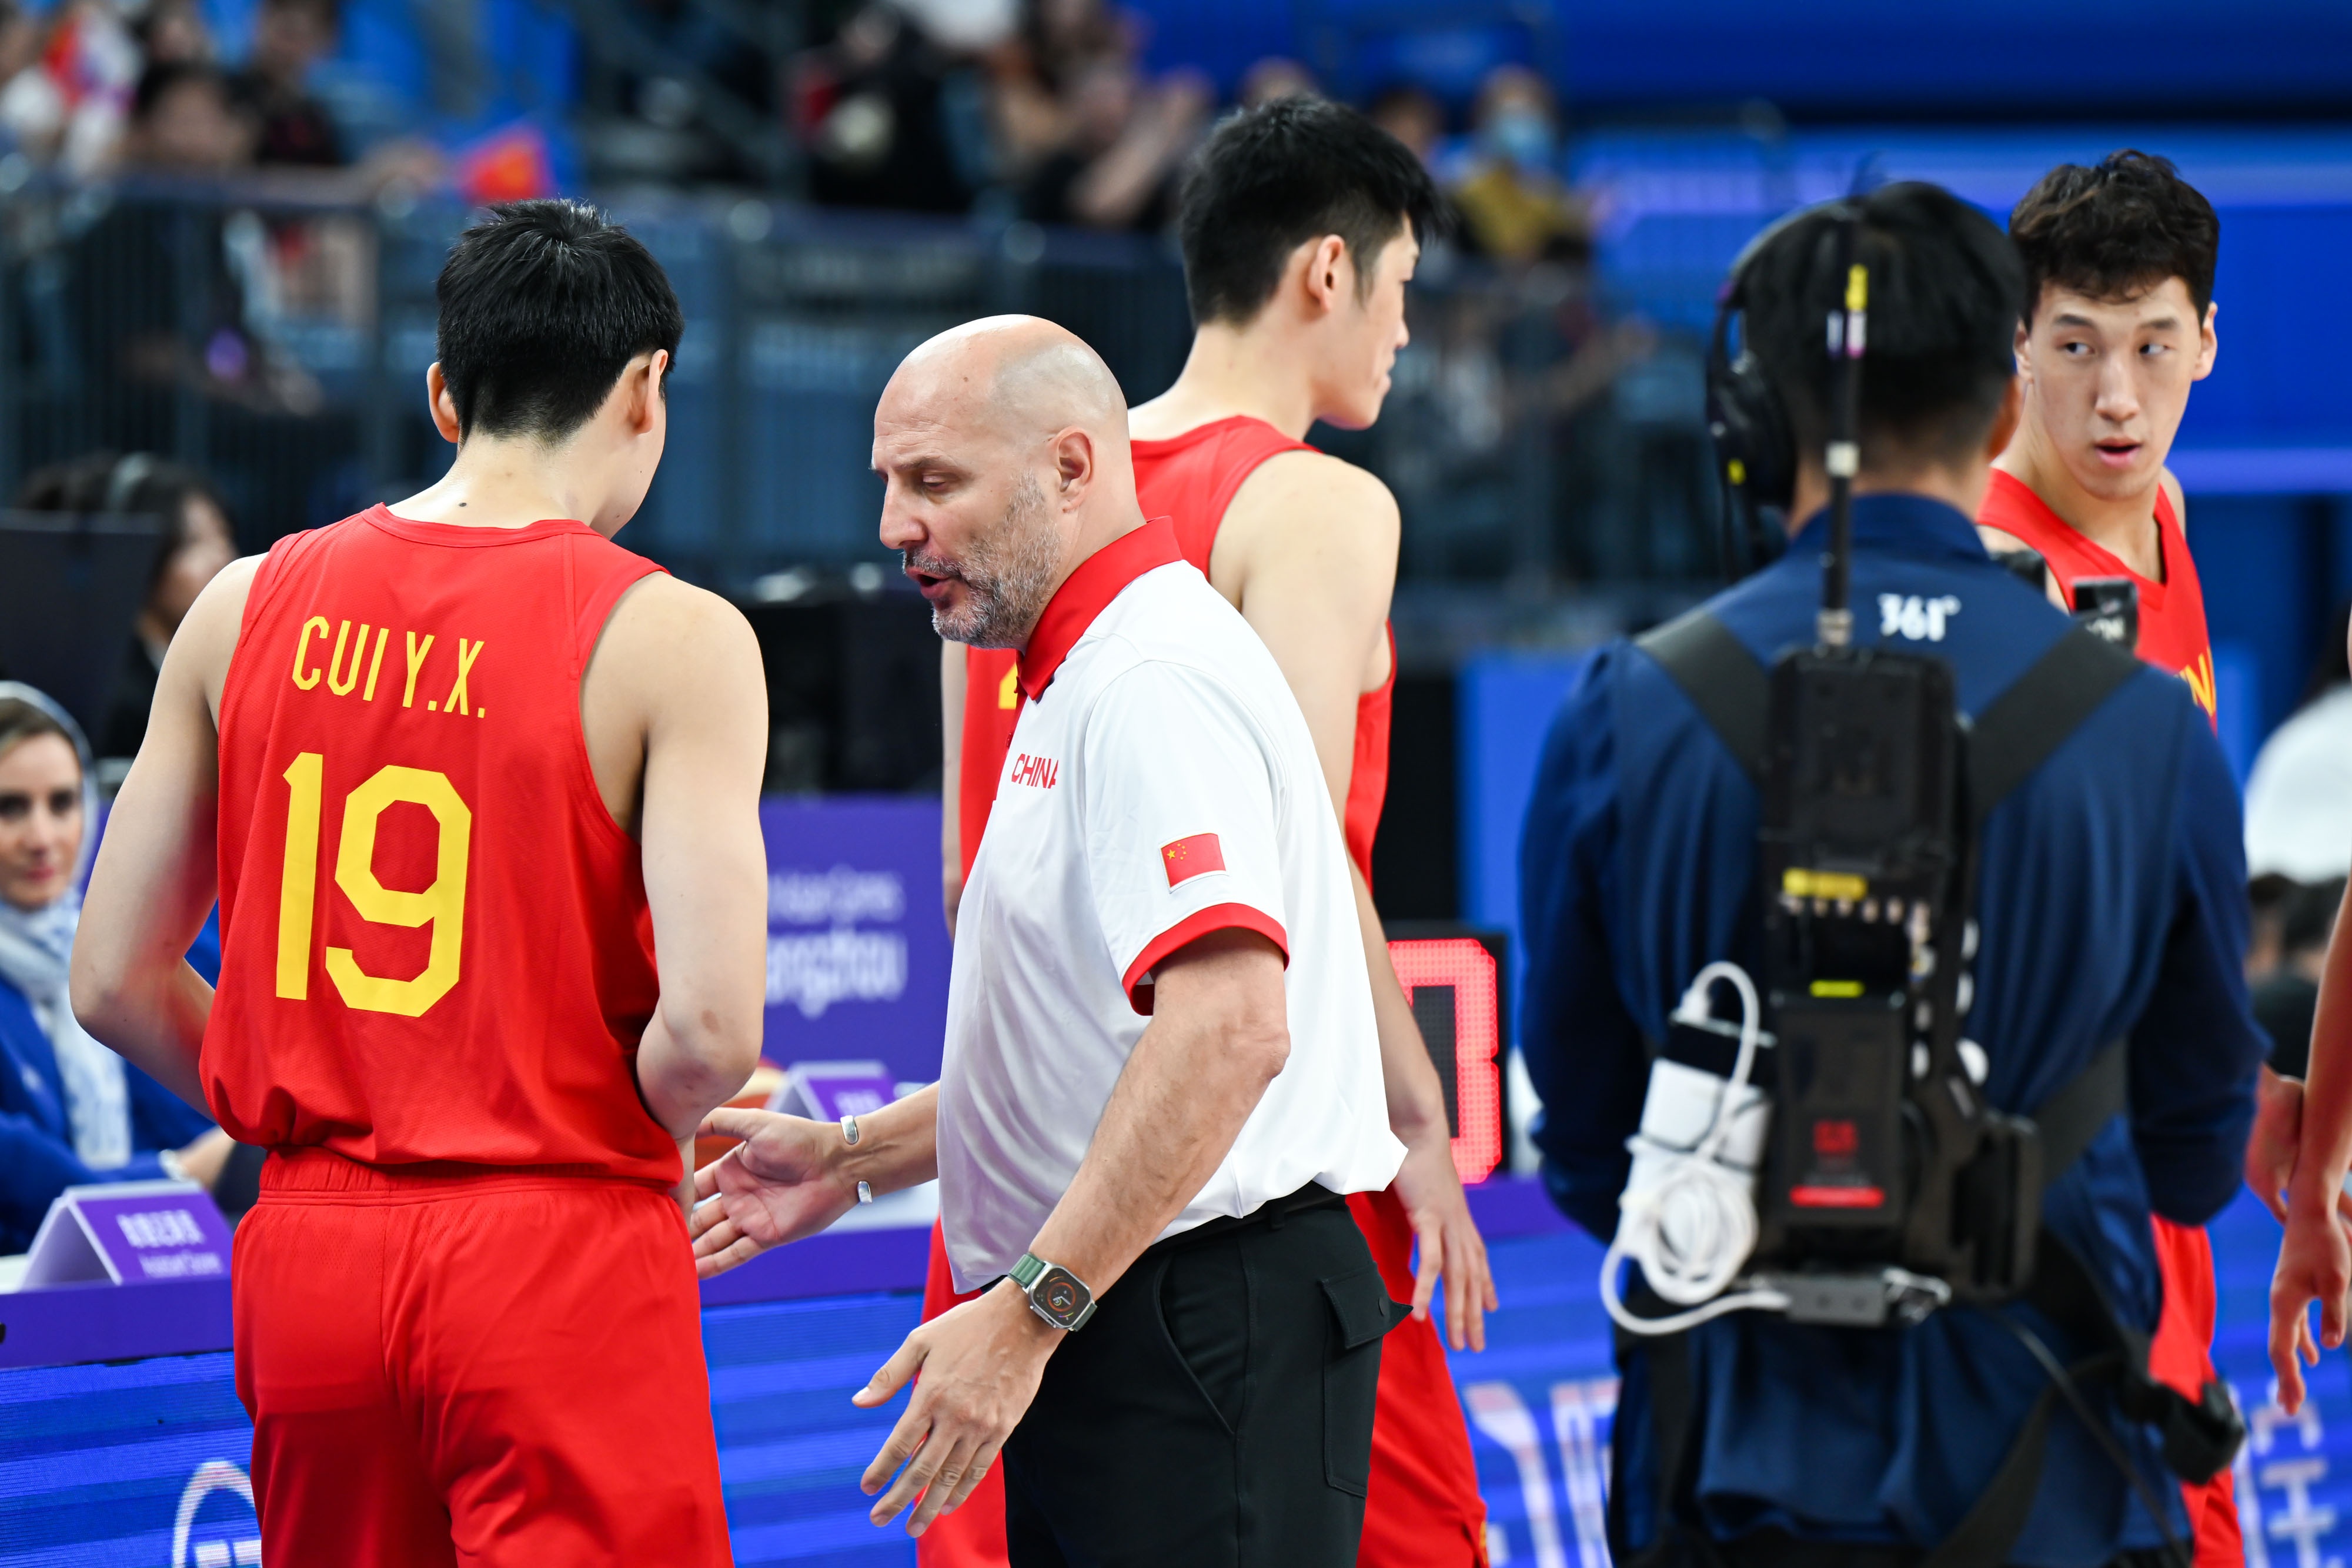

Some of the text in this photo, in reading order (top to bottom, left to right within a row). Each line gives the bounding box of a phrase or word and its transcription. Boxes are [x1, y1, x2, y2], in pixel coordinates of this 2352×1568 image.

[291, 616, 486, 719] CUI Y.X.
[276, 752, 472, 1018] 19
